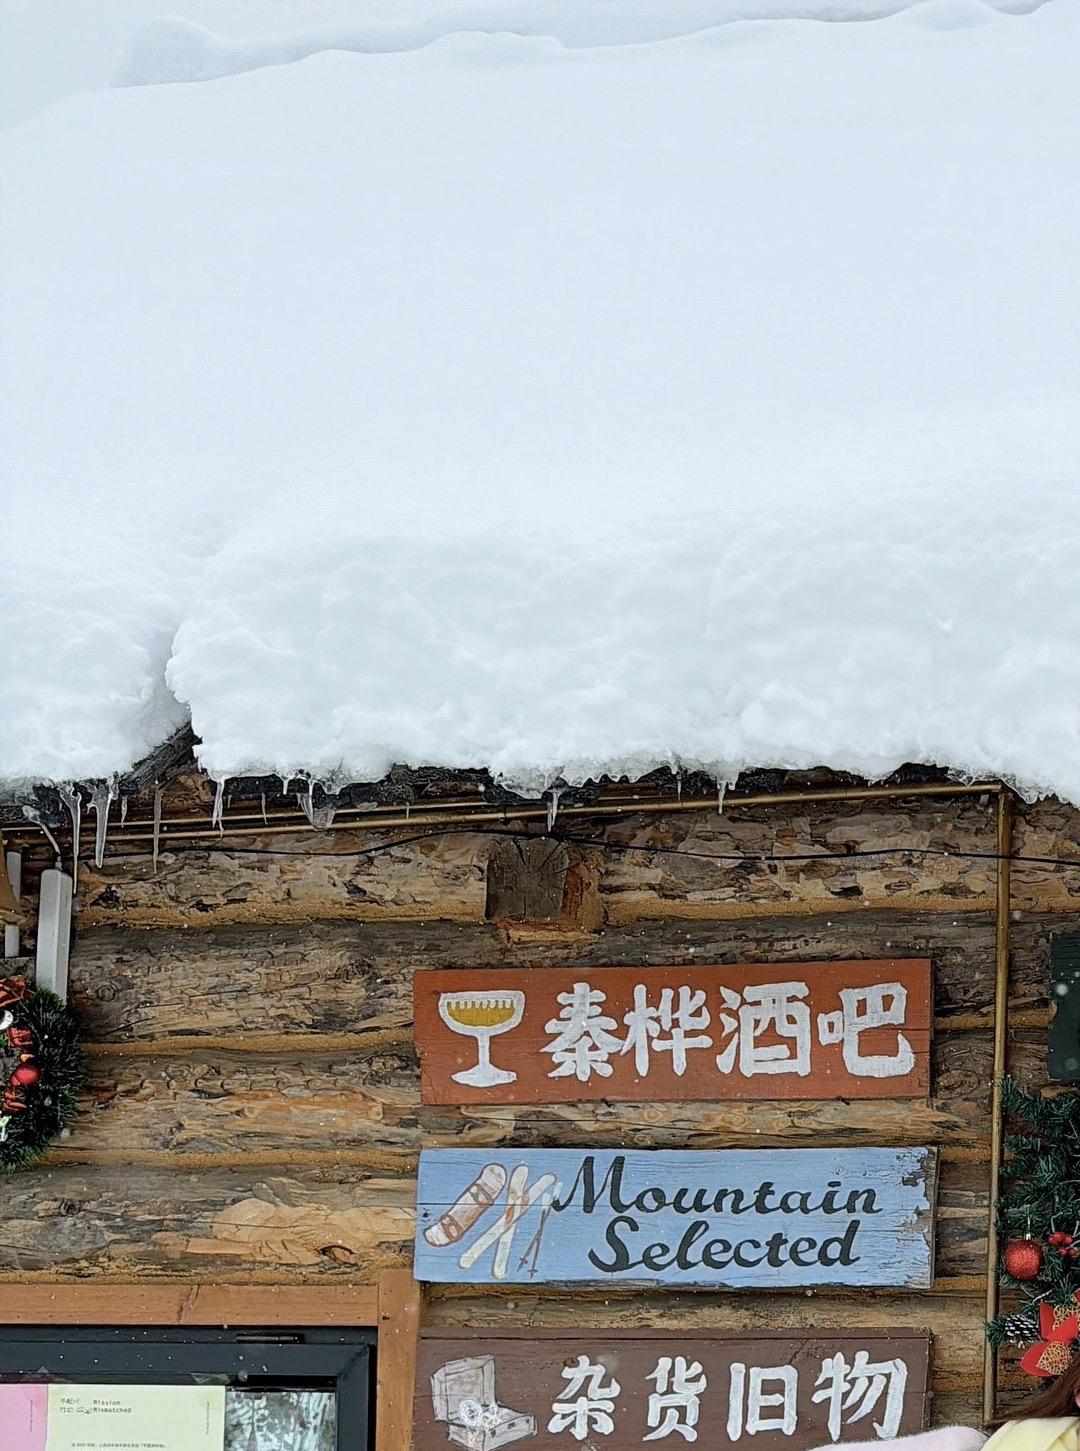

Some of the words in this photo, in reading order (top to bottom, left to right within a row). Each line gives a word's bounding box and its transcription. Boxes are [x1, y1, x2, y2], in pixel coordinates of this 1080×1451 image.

[552, 1155, 883, 1215] Mountain
[586, 1215, 862, 1273] Selected
[546, 1350, 910, 1442] 杂货旧物
